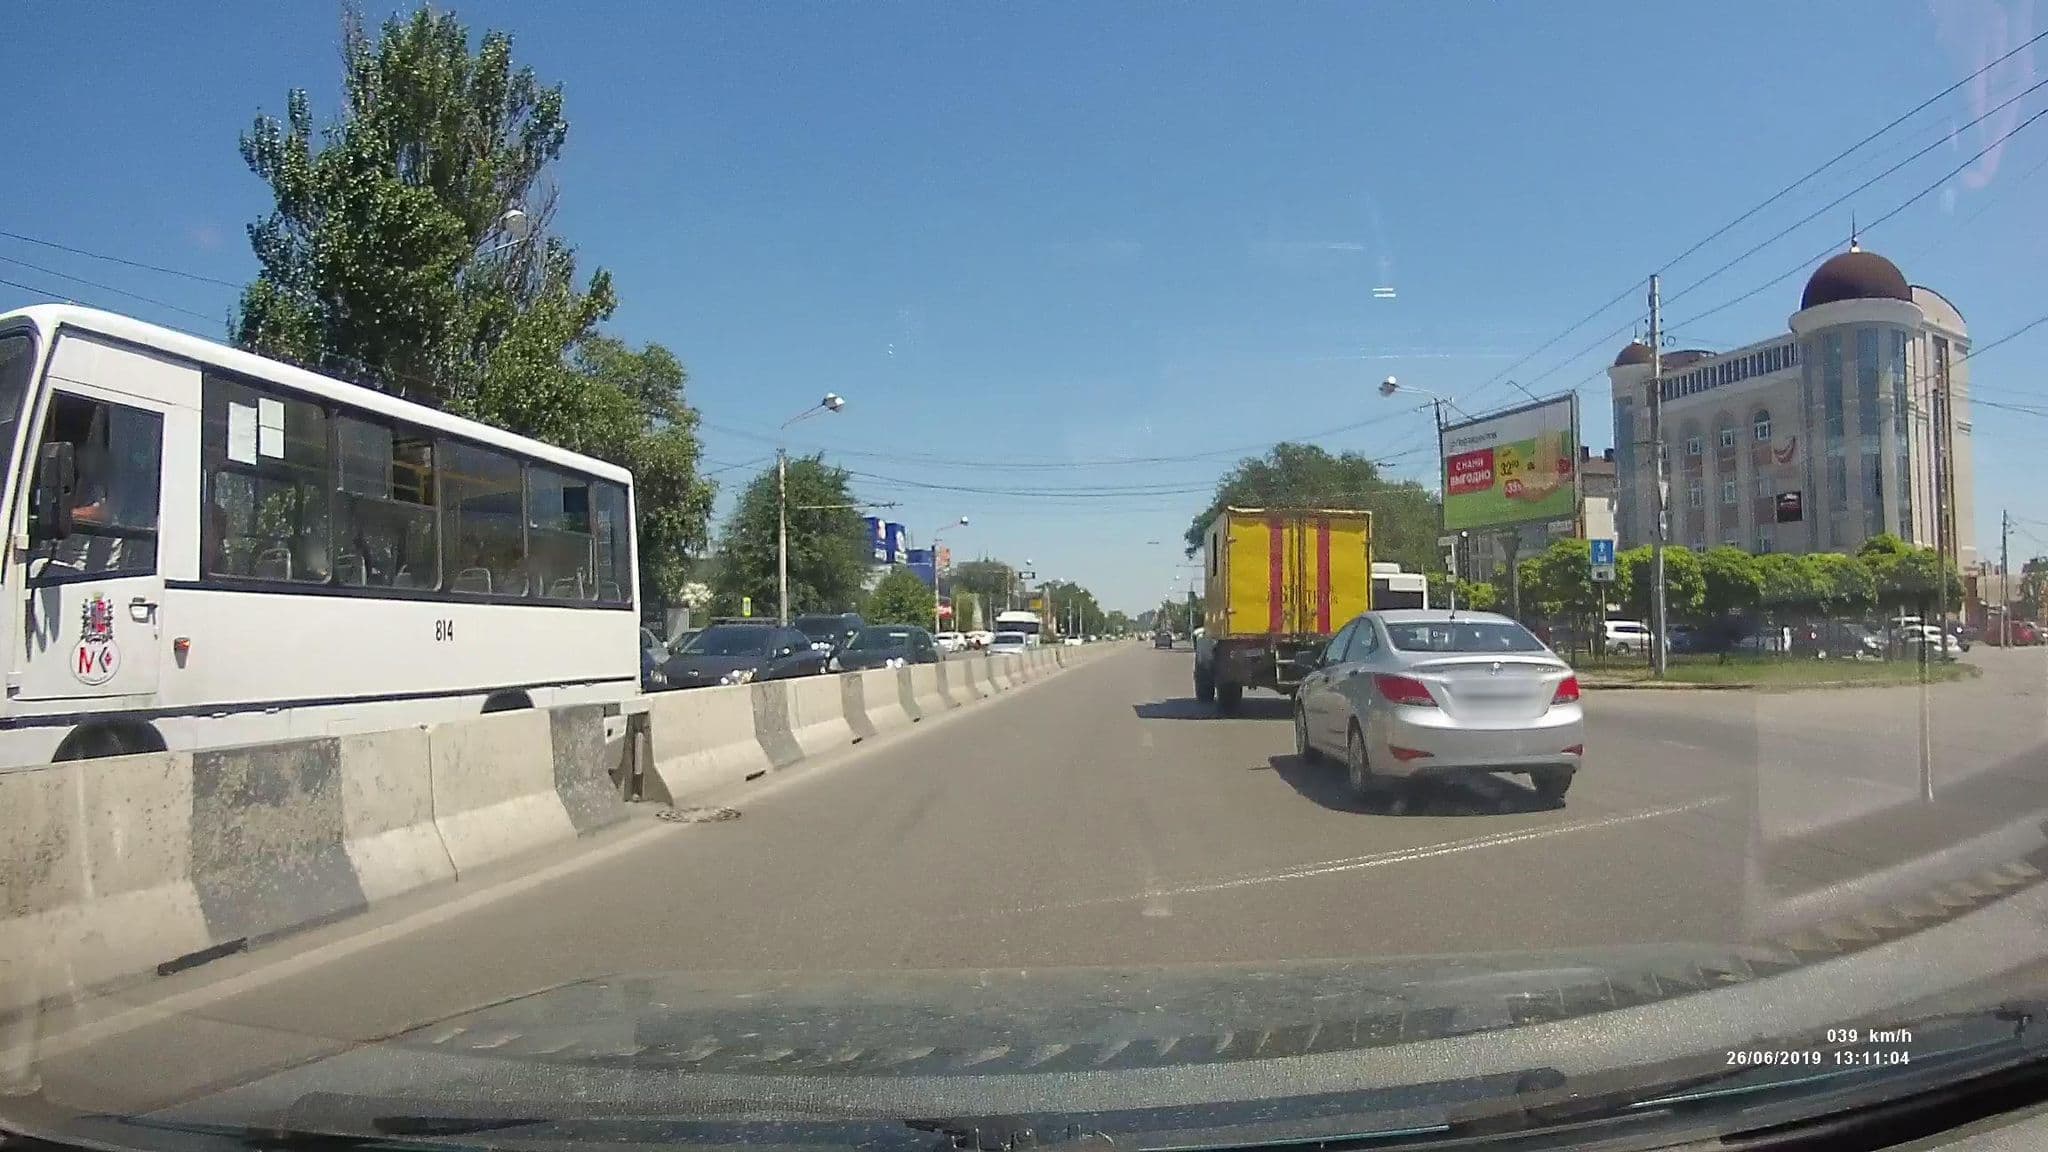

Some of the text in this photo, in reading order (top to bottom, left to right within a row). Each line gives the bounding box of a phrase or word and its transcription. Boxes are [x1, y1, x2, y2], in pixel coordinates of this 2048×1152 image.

[1462, 457, 1484, 470] НАМИ
[1450, 469, 1491, 487] ВЫГОДНО
[436, 620, 453, 641] 814
